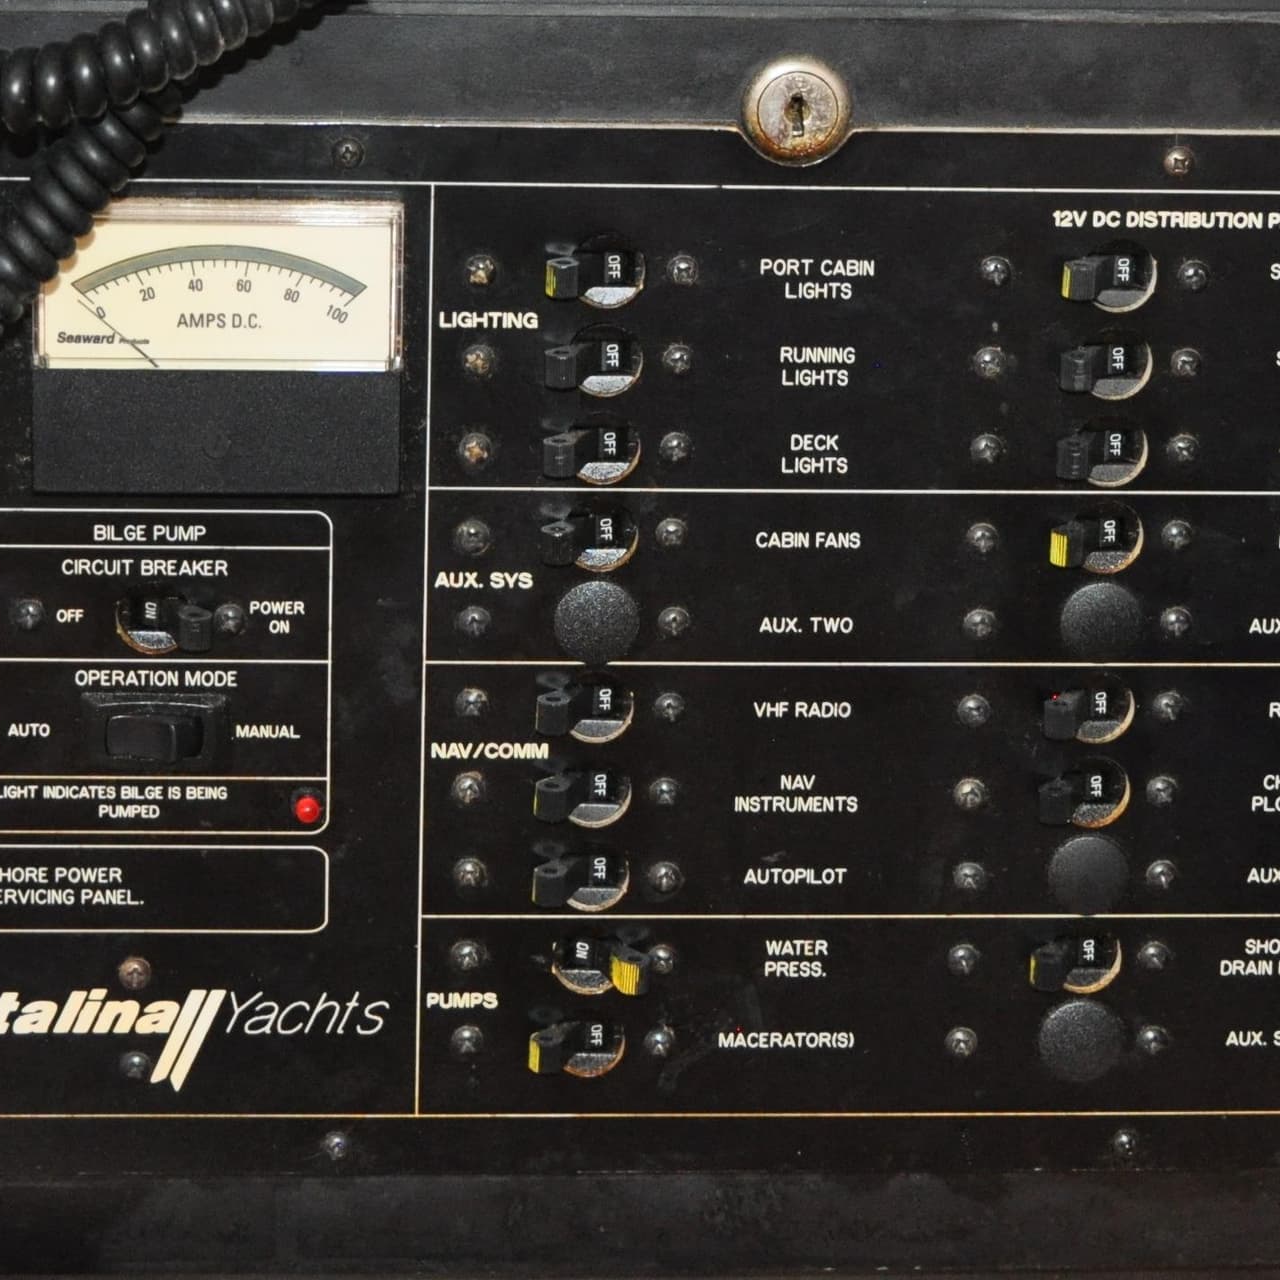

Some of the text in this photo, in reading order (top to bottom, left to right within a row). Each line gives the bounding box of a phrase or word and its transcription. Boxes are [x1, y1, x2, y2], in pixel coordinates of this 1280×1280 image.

[1052, 209, 1088, 228] 12V
[1092, 210, 1122, 228] DC
[1125, 210, 1264, 230] DISTRIBUTION
[759, 258, 875, 277] PORT CABIN
[138, 282, 156, 303] 20
[187, 278, 204, 293] 40
[236, 278, 252, 294] 60
[283, 283, 301, 304] 80
[784, 281, 853, 300] LIGHTS
[176, 312, 262, 329] AMPS D.C.
[438, 311, 539, 329] LIGHTING
[56, 327, 119, 345] Seaward
[779, 346, 856, 365] RUNNING
[781, 368, 849, 387] LIGHTS
[94, 524, 207, 547] BILGE PUMP
[755, 531, 861, 549] CABIN FANS
[61, 558, 229, 577] CIRCUIT BREAKER
[434, 571, 534, 590] AUX. SYS
[74, 669, 238, 688] OPERATION MODE
[753, 701, 852, 719] VHF RADIO
[7, 722, 51, 738] AUTO
[235, 724, 301, 739] MANUAL
[430, 742, 549, 760] NAV/COMM
[734, 795, 858, 813] INSTRUMENTS
[54, 866, 123, 884] POWER
[80, 888, 145, 906] PANEL.
[426, 991, 499, 1010] PUMPS
[226, 991, 389, 1036] Yachts
[718, 1031, 855, 1049] MACERATOR(S)
